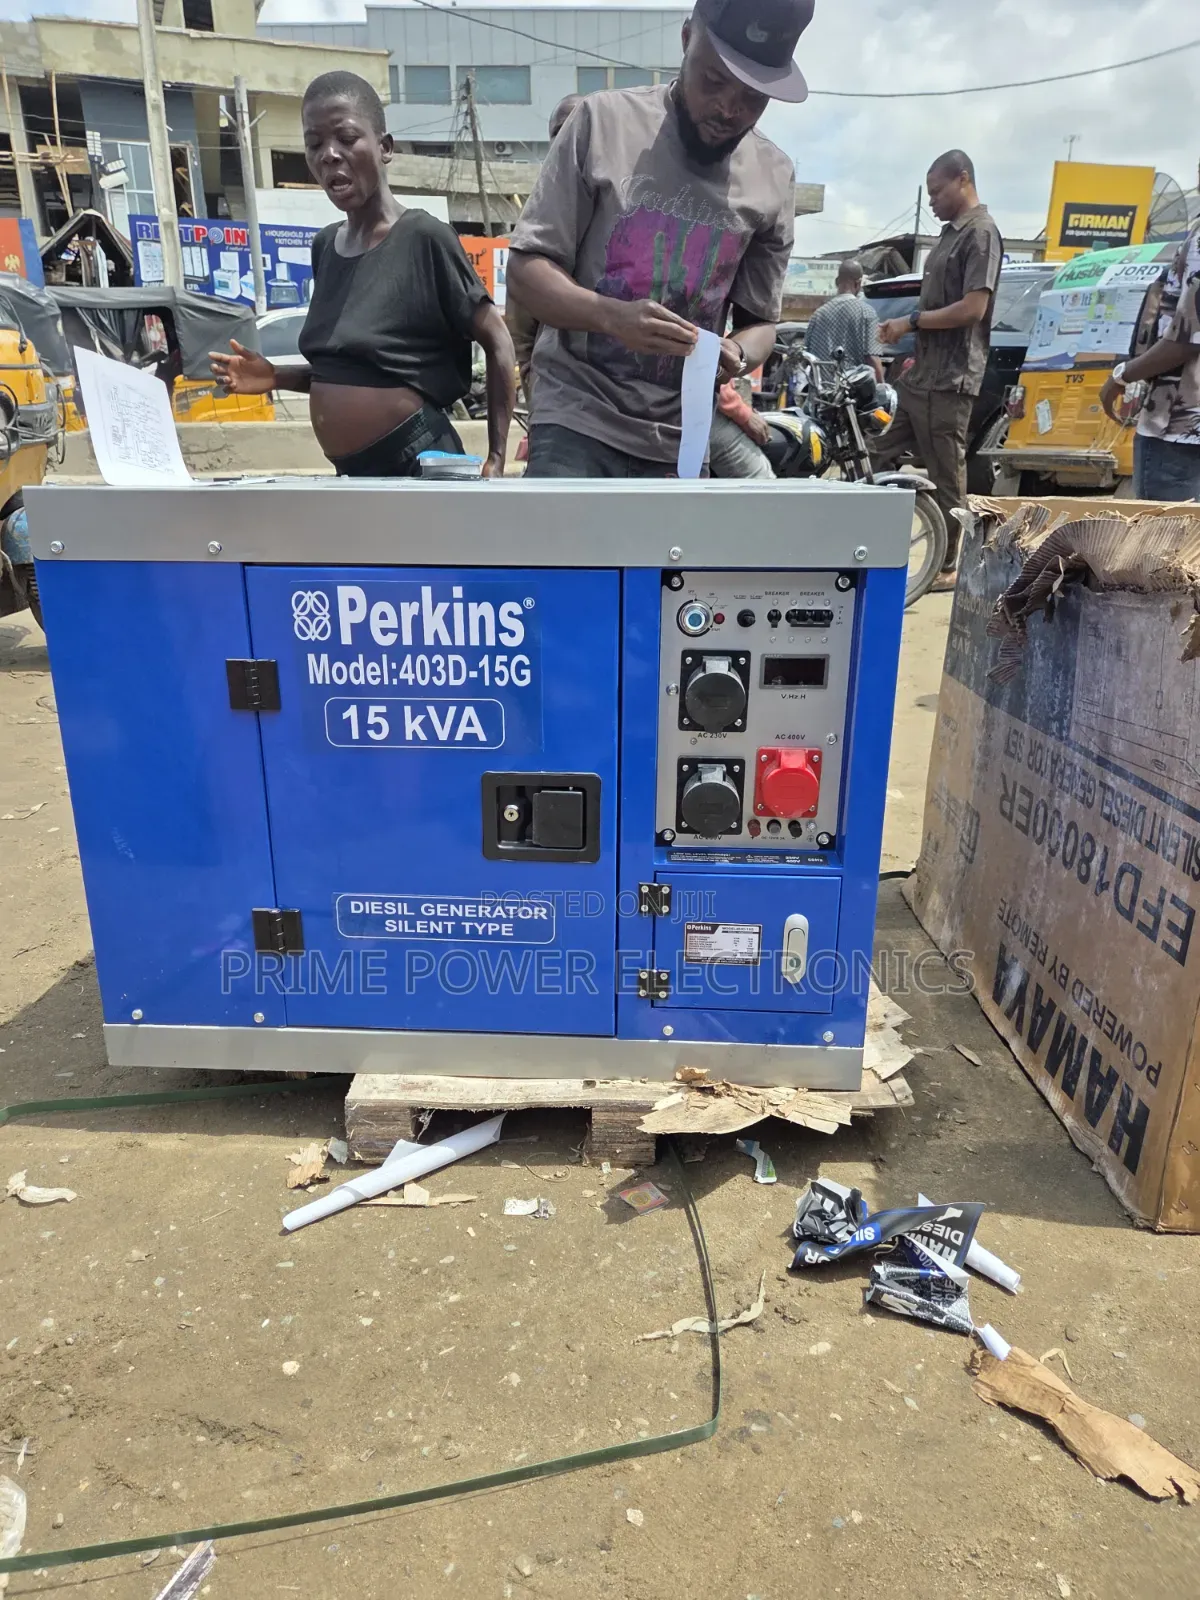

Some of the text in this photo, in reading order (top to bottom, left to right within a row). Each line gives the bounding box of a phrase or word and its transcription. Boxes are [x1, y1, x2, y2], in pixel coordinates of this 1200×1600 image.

[1068, 213, 1130, 230] FIRMAN
[1114, 264, 1161, 278] JORD
[1065, 374, 1085, 384] TVS
[307, 653, 532, 688] Model:403D-15G
[342, 704, 487, 742] 15 kVA
[1003, 725, 1200, 883] SILENT DIESEL GENERATOR SET
[350, 900, 548, 920] DIESIL GENERATOR
[384, 919, 515, 936] SILENT TYPE
[997, 897, 1163, 1089] POWERED BY REMOTE
